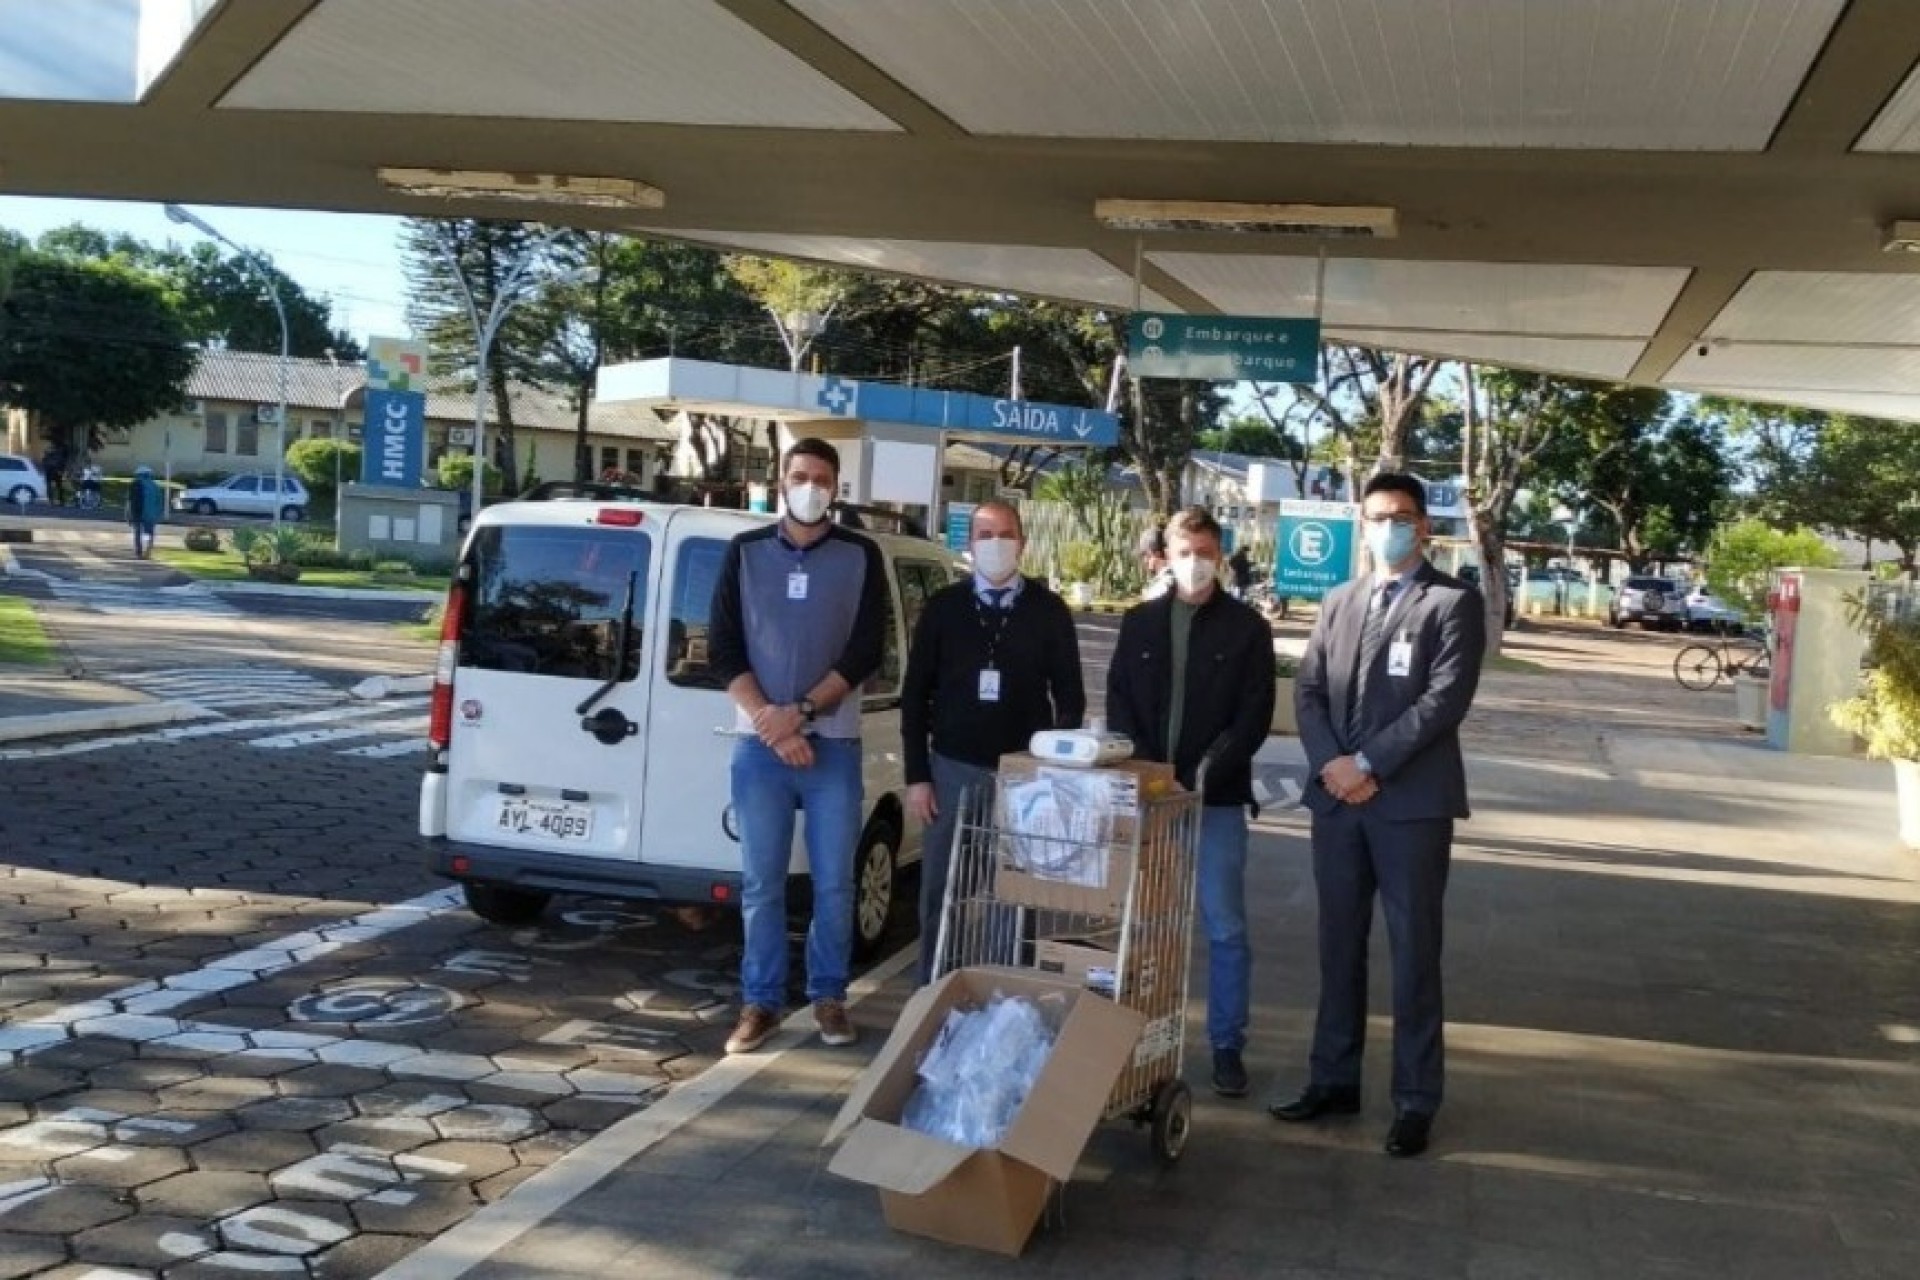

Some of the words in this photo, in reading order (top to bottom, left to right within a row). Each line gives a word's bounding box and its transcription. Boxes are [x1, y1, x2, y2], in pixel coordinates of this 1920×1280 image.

[1185, 326, 1274, 345] Embarque
[1279, 332, 1289, 344] e
[992, 399, 1059, 432] SAÍDA
[381, 402, 408, 480] HMCC
[1299, 530, 1323, 559] E
